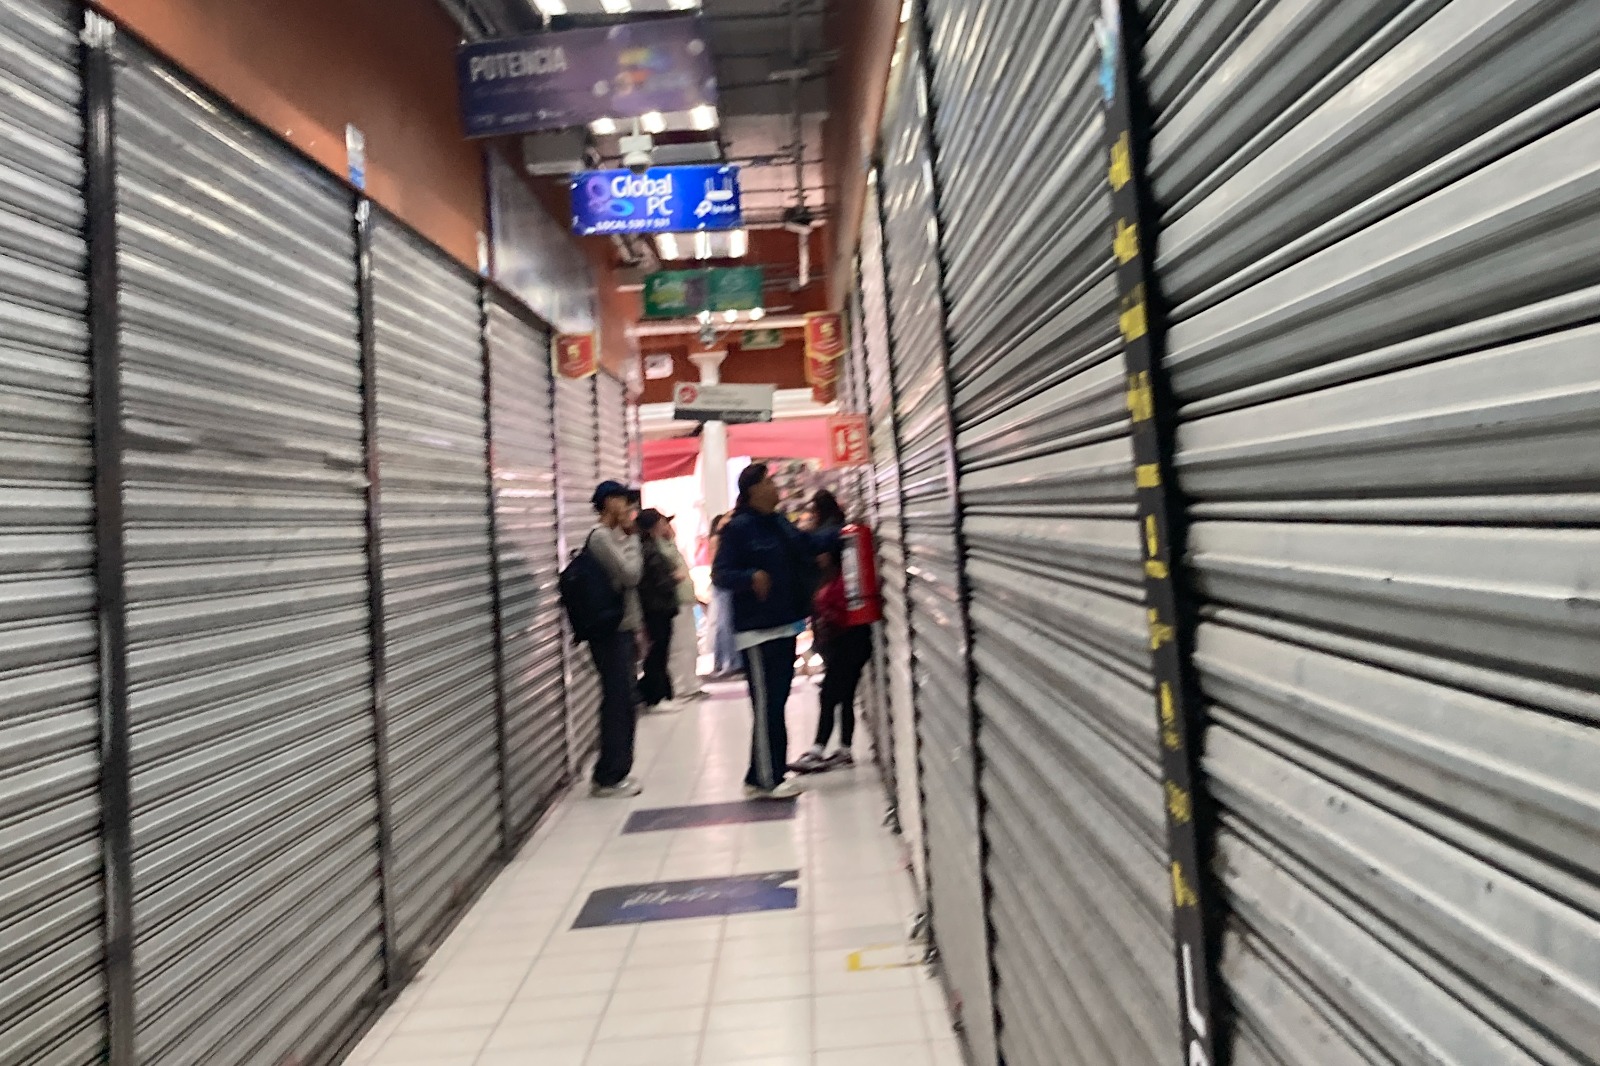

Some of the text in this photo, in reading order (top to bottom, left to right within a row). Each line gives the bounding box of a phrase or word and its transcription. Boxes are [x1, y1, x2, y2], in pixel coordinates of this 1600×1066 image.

[469, 47, 568, 82] POTENCIA
[611, 173, 673, 199] Global
[646, 195, 674, 216] PC
